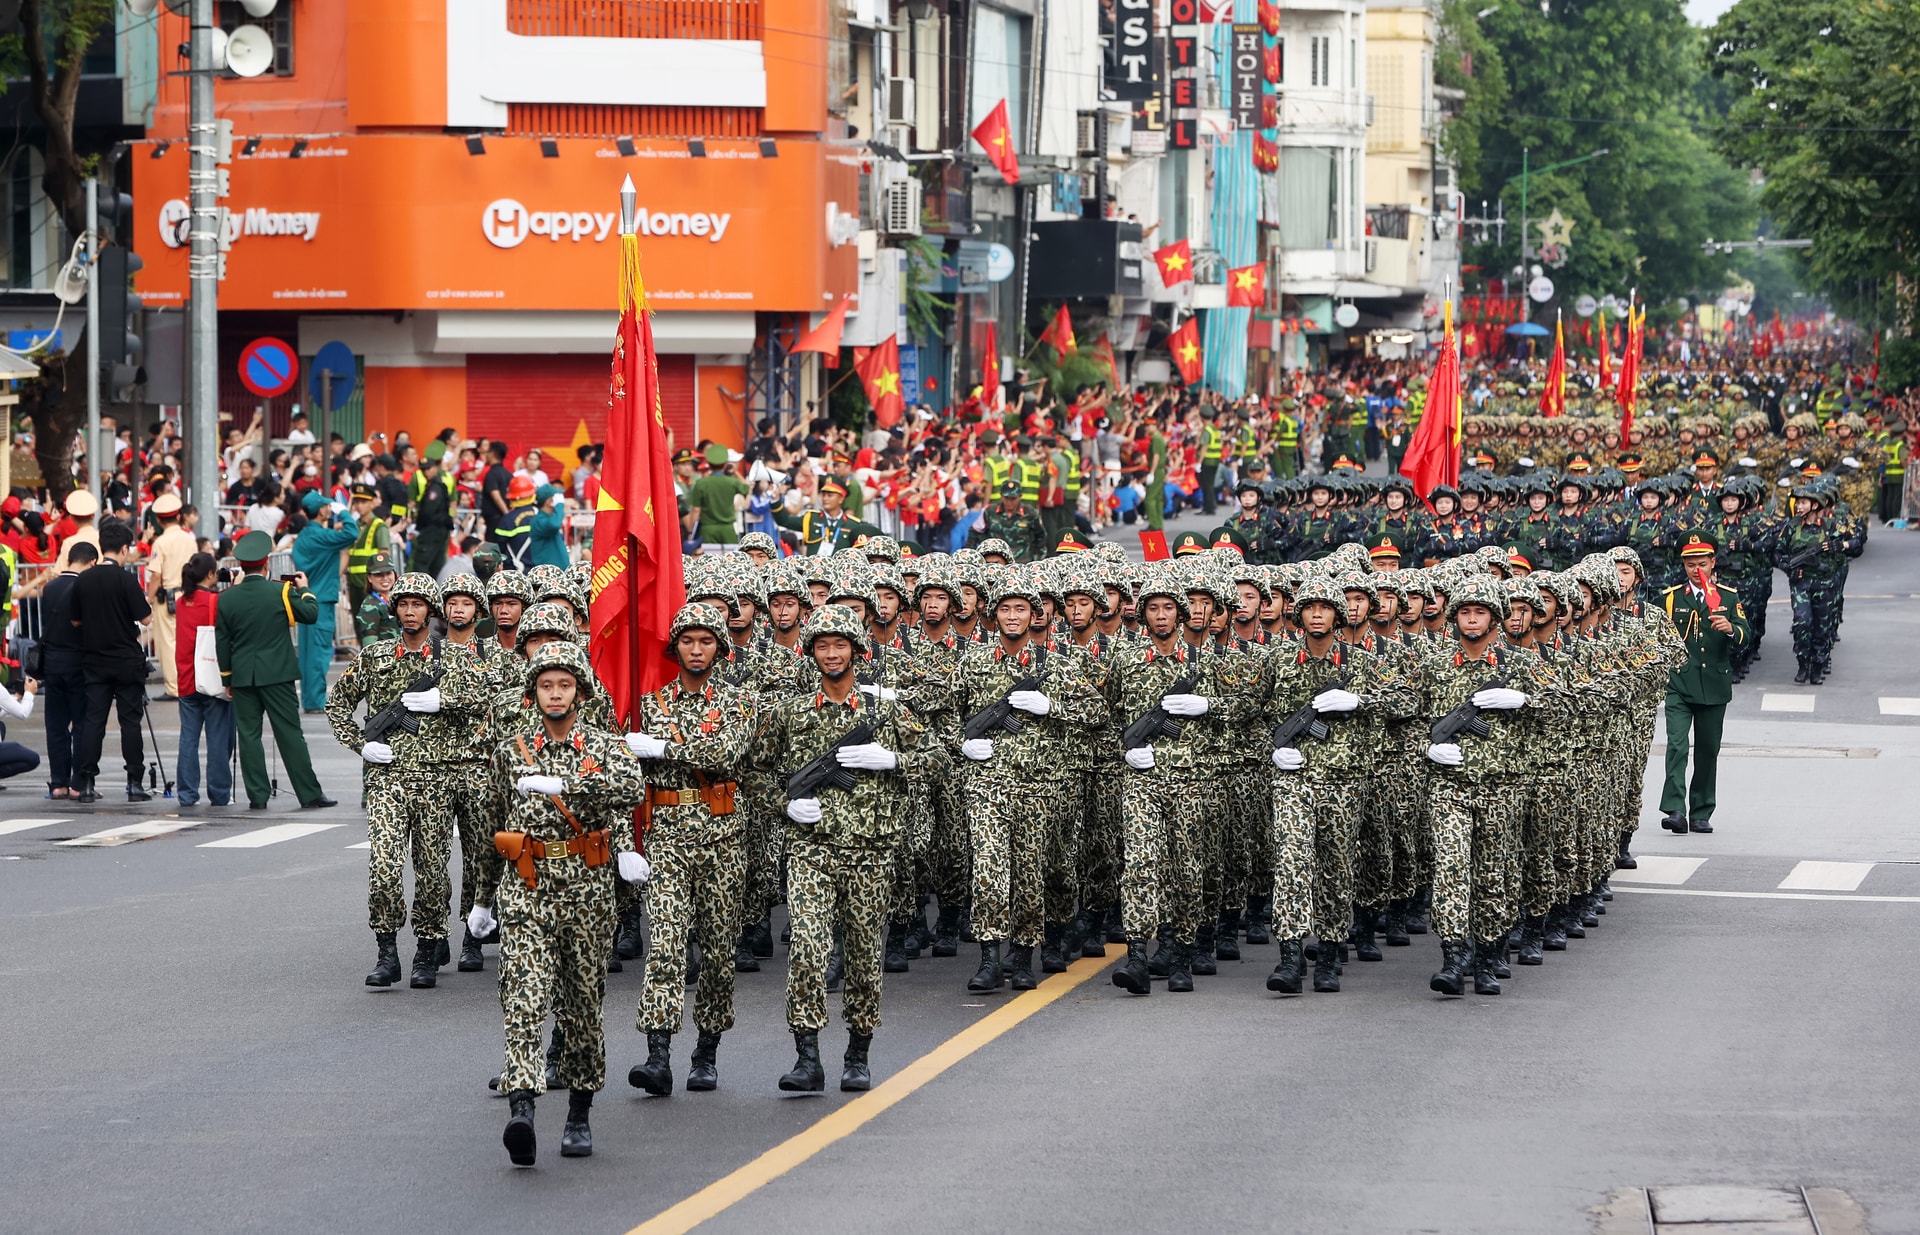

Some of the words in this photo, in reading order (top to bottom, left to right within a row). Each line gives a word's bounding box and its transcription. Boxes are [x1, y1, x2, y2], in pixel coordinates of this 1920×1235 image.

[1236, 34, 1259, 129] HOTEL
[243, 207, 320, 241] Money
[482, 198, 616, 249] Happy
